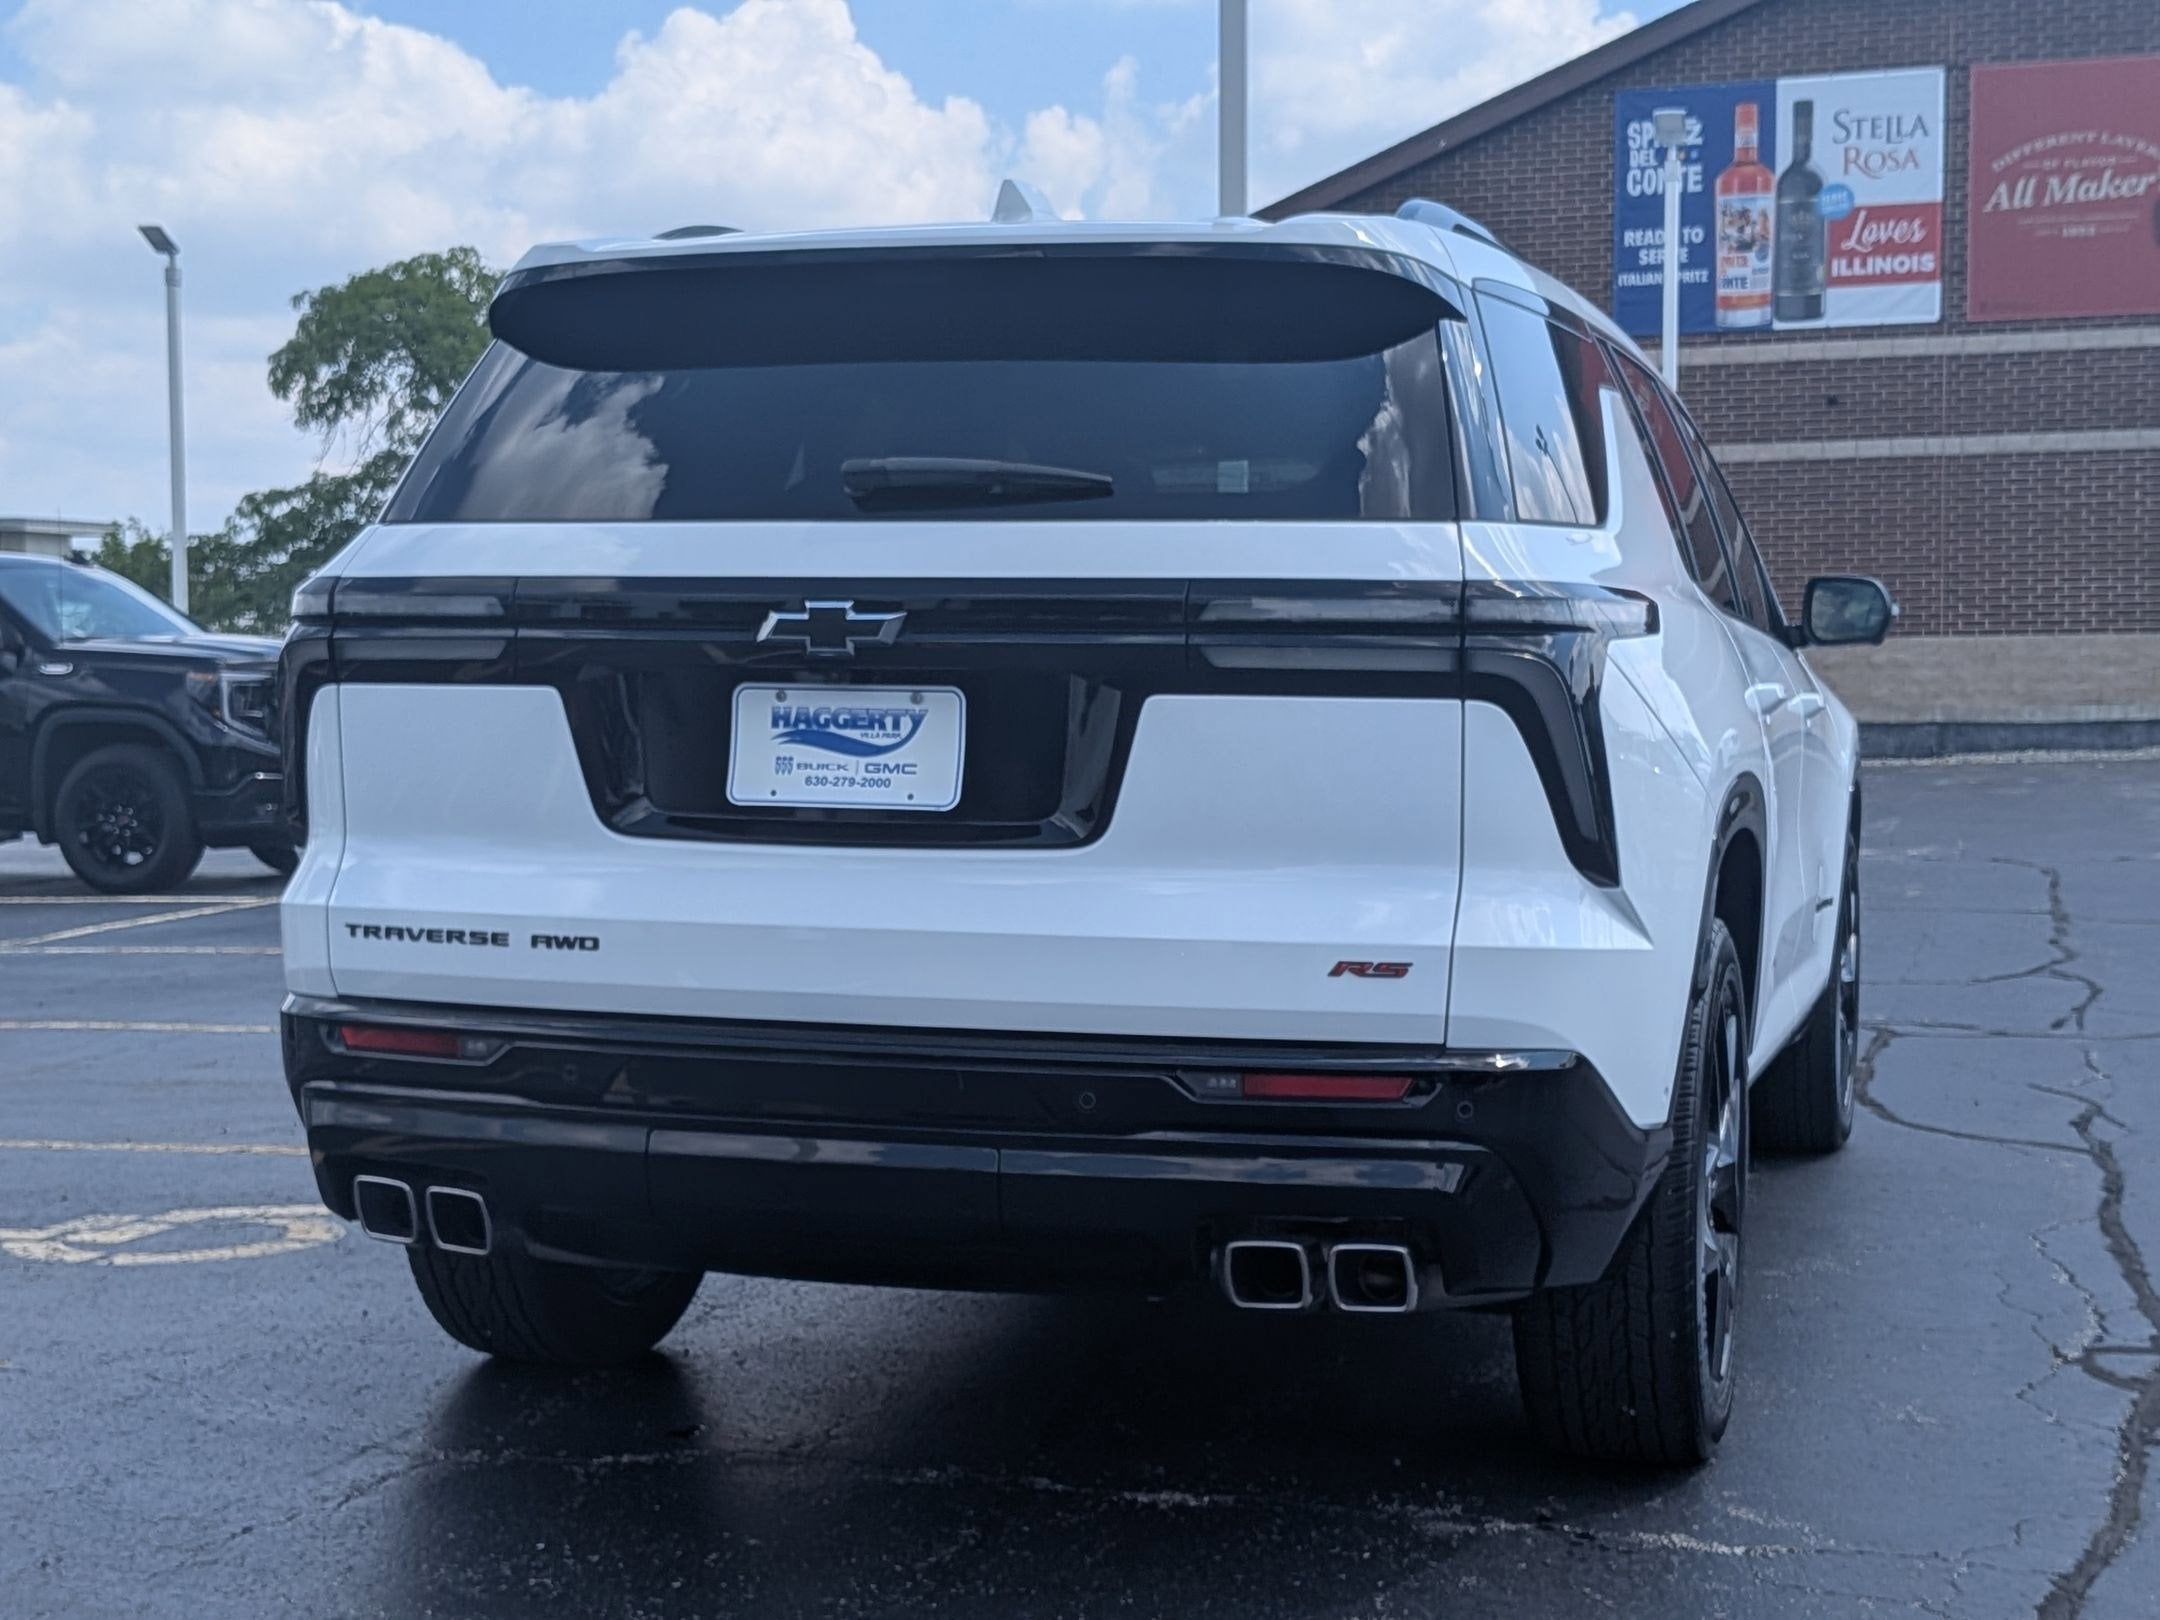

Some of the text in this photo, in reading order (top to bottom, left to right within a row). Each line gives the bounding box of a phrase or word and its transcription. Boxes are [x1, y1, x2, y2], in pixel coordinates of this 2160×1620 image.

[1627, 118, 1703, 149] SPZ
[1832, 108, 1929, 145] STELLA
[1629, 149, 1658, 168] DEL
[1843, 146, 1920, 180] ROSA
[1982, 175, 2038, 213] All
[1623, 227, 1705, 248] READ TO
[1840, 209, 1929, 253] Loves
[1831, 253, 1936, 278] ILLINOIS
[1618, 271, 1664, 287] ITALIAN
[770, 706, 929, 732] HAGGERTY
[859, 731, 880, 740] VILLA
[796, 762, 918, 776] BUICK GMC
[804, 775, 892, 789] 630-279-2000
[345, 922, 600, 952] TRAVERSE AWD
[1327, 960, 1414, 979] RS
